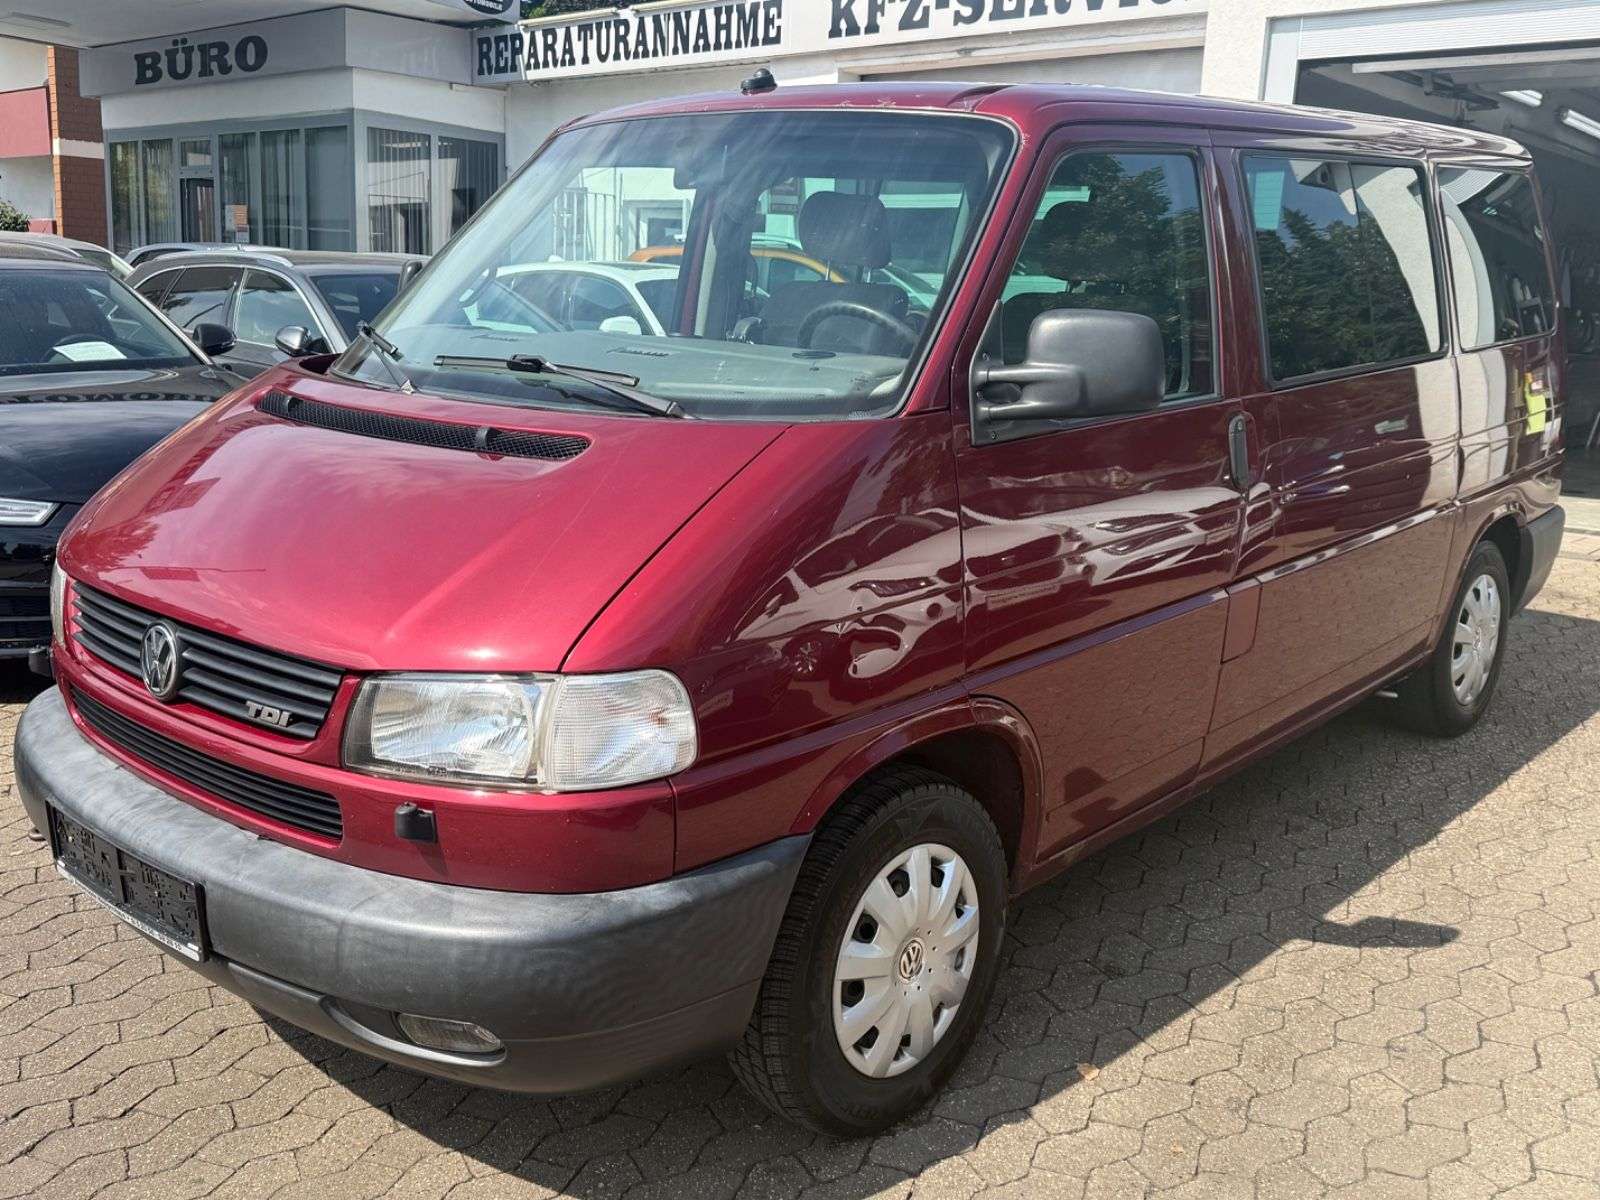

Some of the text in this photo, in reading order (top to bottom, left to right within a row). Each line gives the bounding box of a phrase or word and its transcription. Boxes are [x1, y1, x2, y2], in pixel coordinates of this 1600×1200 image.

[134, 35, 269, 85] BÜRO
[477, 0, 782, 76] REPARATURANNAHME
[246, 700, 291, 728] TDI
